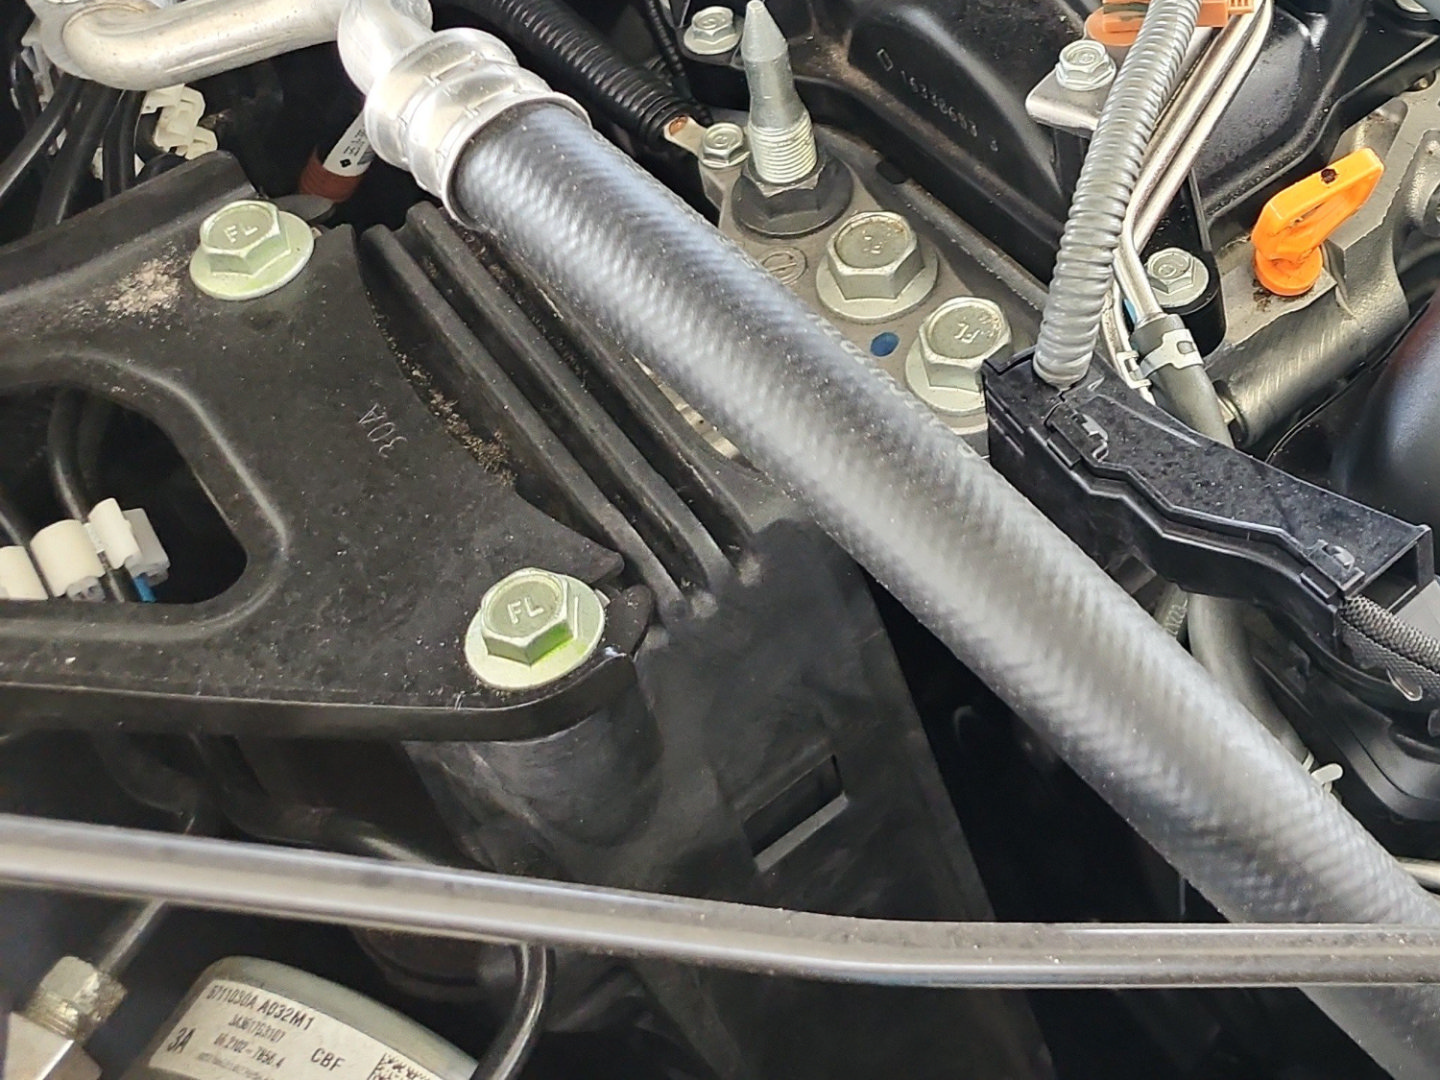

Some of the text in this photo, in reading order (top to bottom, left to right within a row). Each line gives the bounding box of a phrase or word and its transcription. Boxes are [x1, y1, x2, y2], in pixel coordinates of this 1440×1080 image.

[224, 221, 258, 243] FL
[358, 402, 407, 458] 30A
[507, 596, 544, 624] FL
[167, 1027, 195, 1054] 3A
[311, 1047, 345, 1071] CBF
